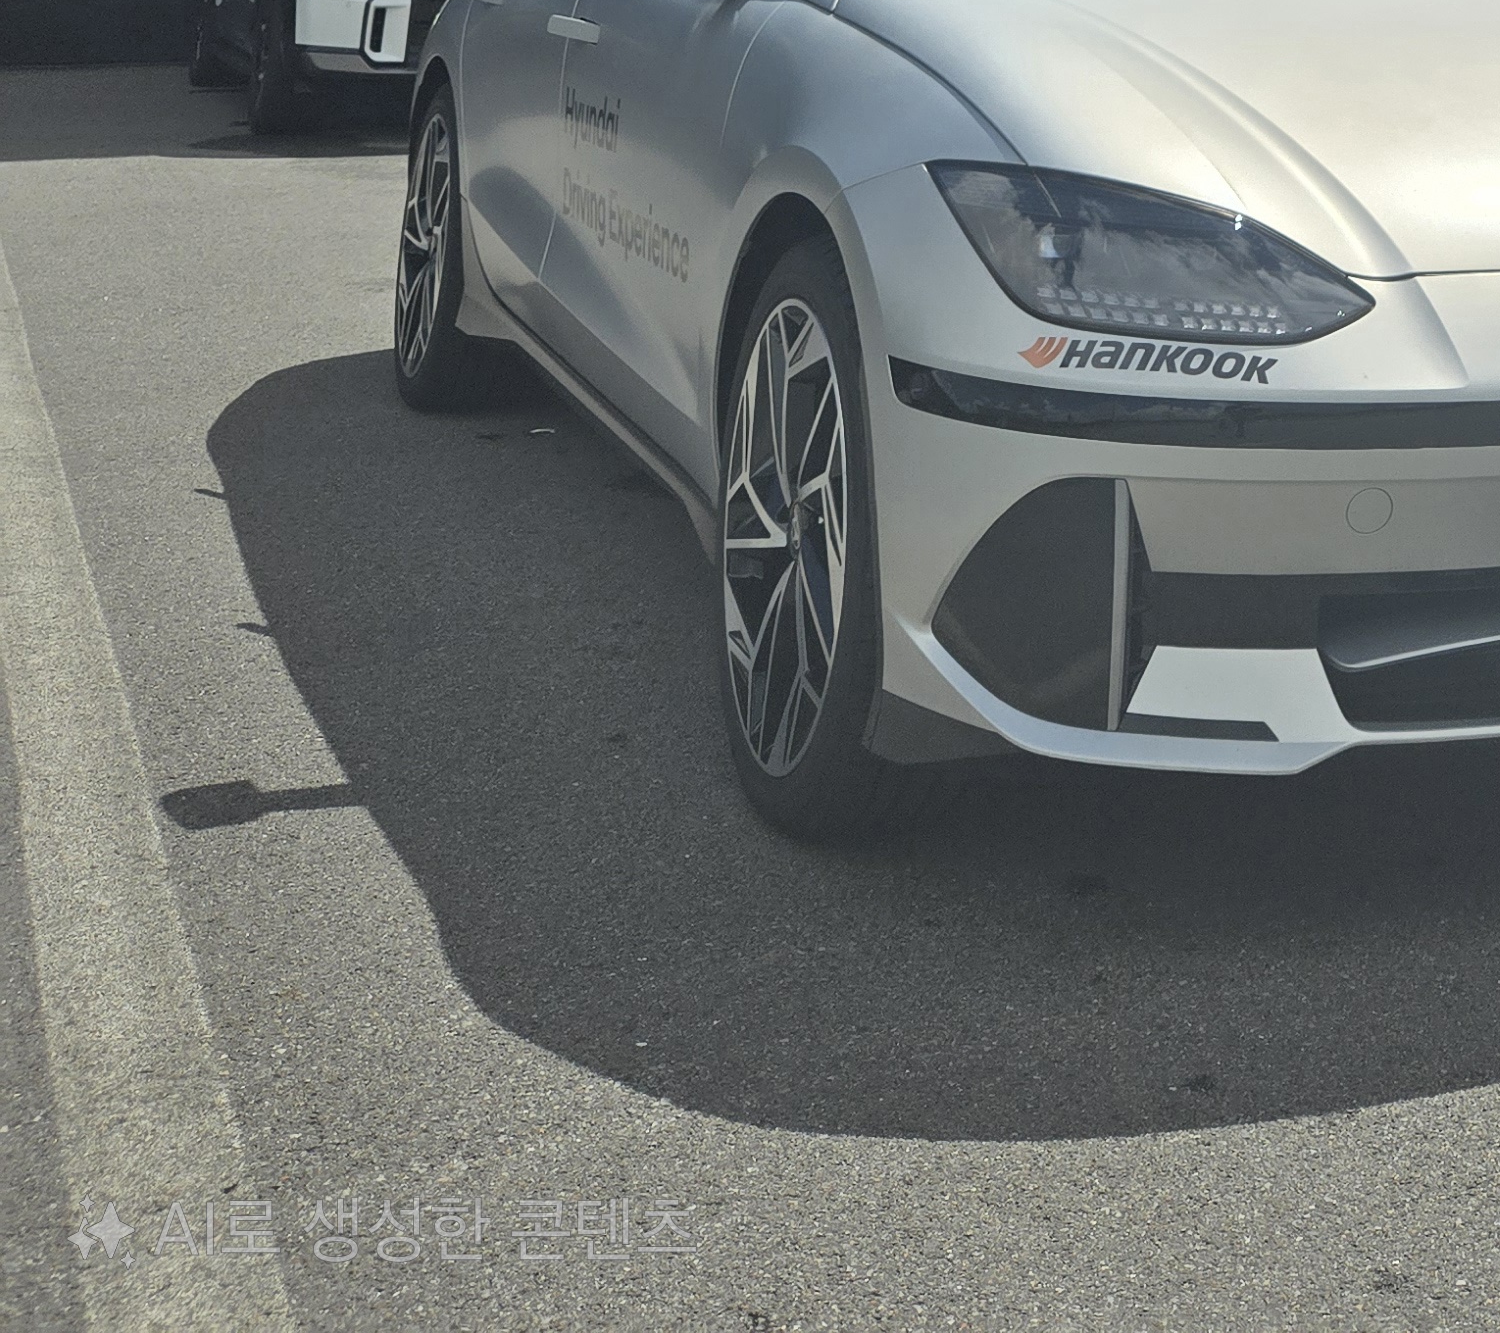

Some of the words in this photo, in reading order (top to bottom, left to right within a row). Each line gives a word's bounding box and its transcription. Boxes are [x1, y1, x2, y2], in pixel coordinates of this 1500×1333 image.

[565, 87, 621, 153] Hyundai
[563, 167, 606, 247] Driving
[609, 189, 690, 283] Experience
